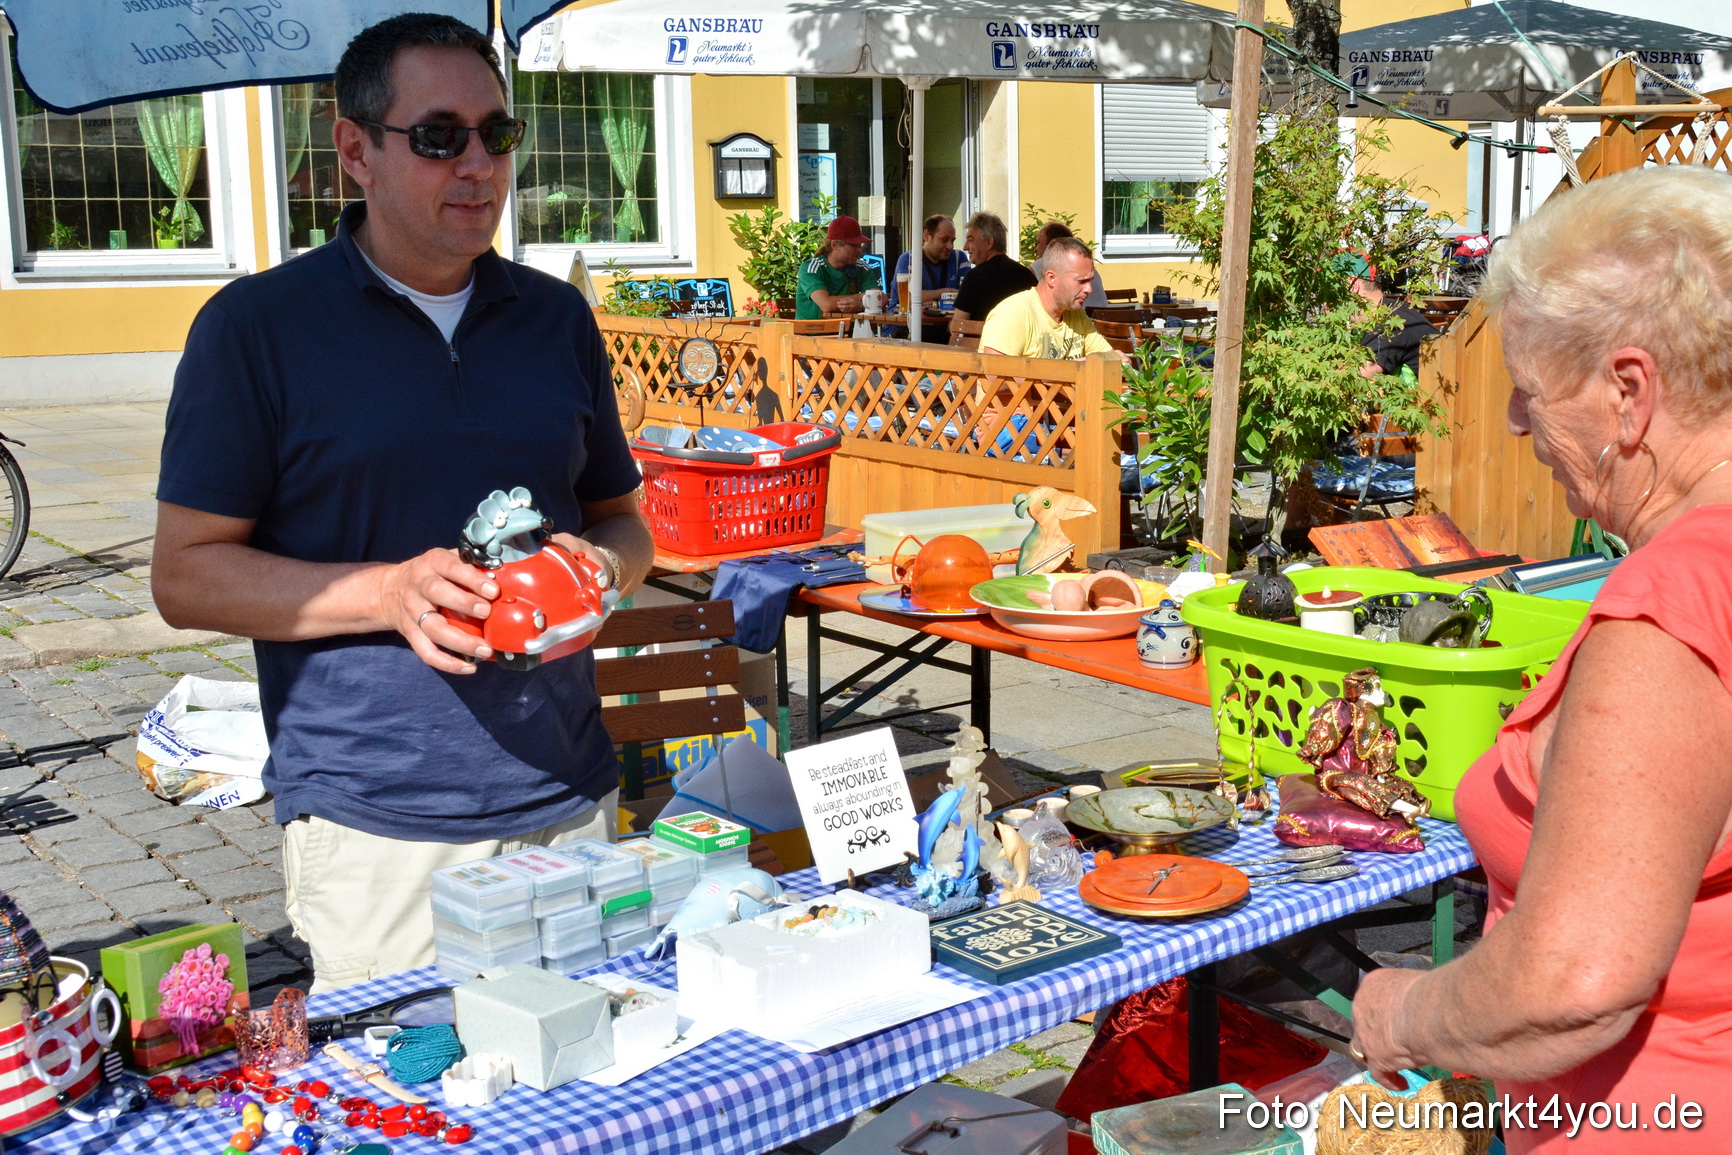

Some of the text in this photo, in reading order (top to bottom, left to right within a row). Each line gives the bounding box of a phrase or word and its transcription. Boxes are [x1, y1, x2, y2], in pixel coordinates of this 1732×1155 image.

[663, 17, 763, 33] GANSBRÄU
[986, 22, 1100, 38] GANSBRÄU
[697, 39, 752, 54] Neumarkt's
[1027, 45, 1092, 60] Neumarkt's
[692, 53, 756, 66] guter Schluck
[1349, 49, 1434, 63] GANSBRÄU
[1024, 58, 1098, 71] guter Schluck
[1378, 68, 1425, 79] Neumarkt's
[1373, 78, 1428, 88] guter Schluck
[808, 748, 887, 782] Be steadfast and
[820, 765, 888, 797] IMMOVABLE
[812, 780, 902, 815] always abounding in
[823, 796, 904, 832] GOOD WORKS
[931, 908, 1038, 942] faith
[980, 929, 1089, 964] love
